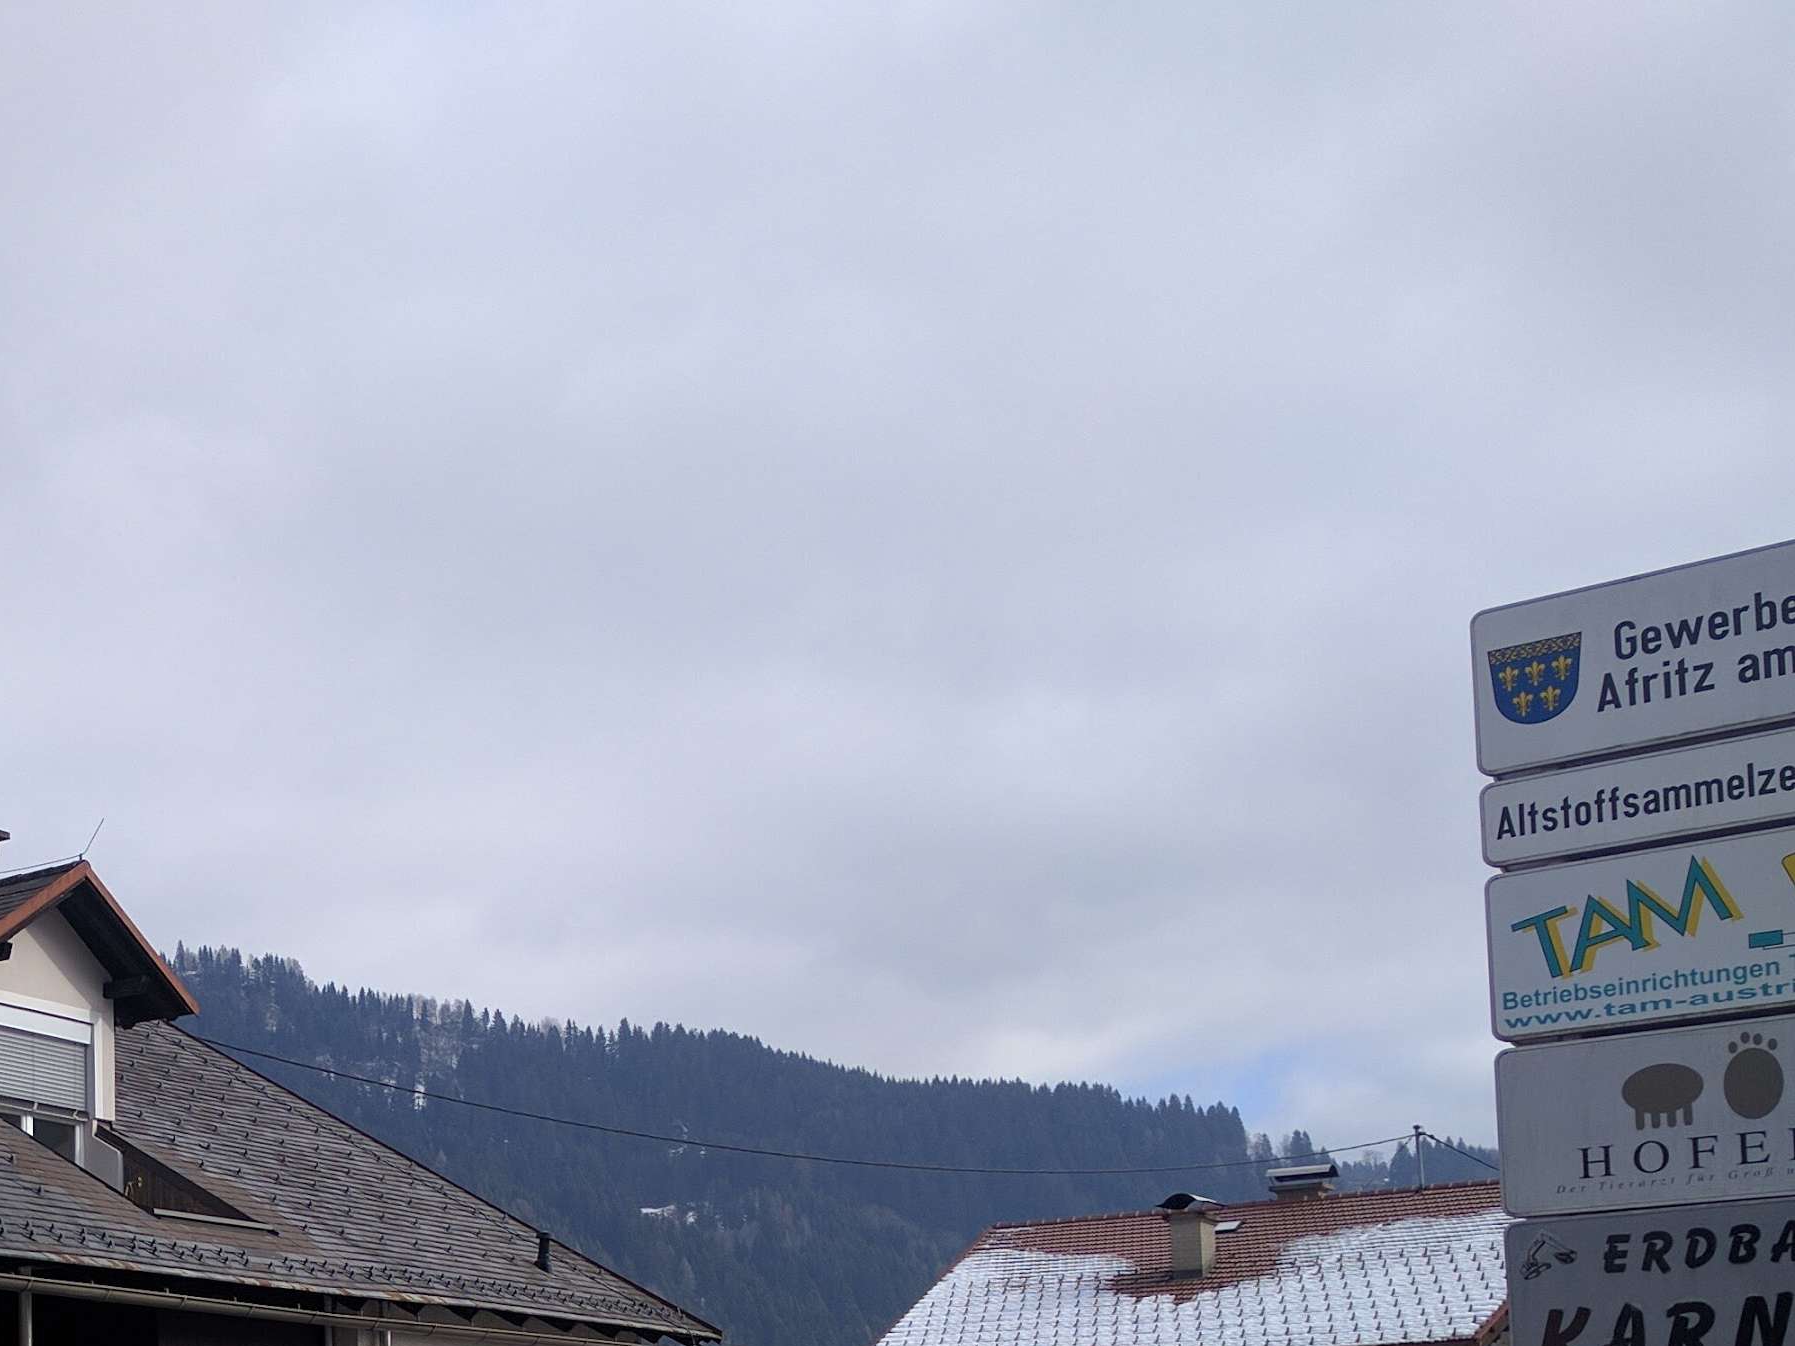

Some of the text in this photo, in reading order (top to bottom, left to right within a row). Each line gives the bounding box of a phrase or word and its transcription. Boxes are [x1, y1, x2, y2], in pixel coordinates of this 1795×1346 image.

[1613, 591, 1795, 661] Gewerbe
[1597, 645, 1795, 713] Afritz am
[1497, 762, 1795, 840] Altstoffsammelze
[1511, 855, 1744, 979] TAM
[1502, 960, 1781, 1011] Betriebseinrichtungen
[1556, 1184, 1587, 1194] Der
[1598, 1176, 1676, 1191] Tierarzt
[1578, 1127, 1795, 1179] HOFE
